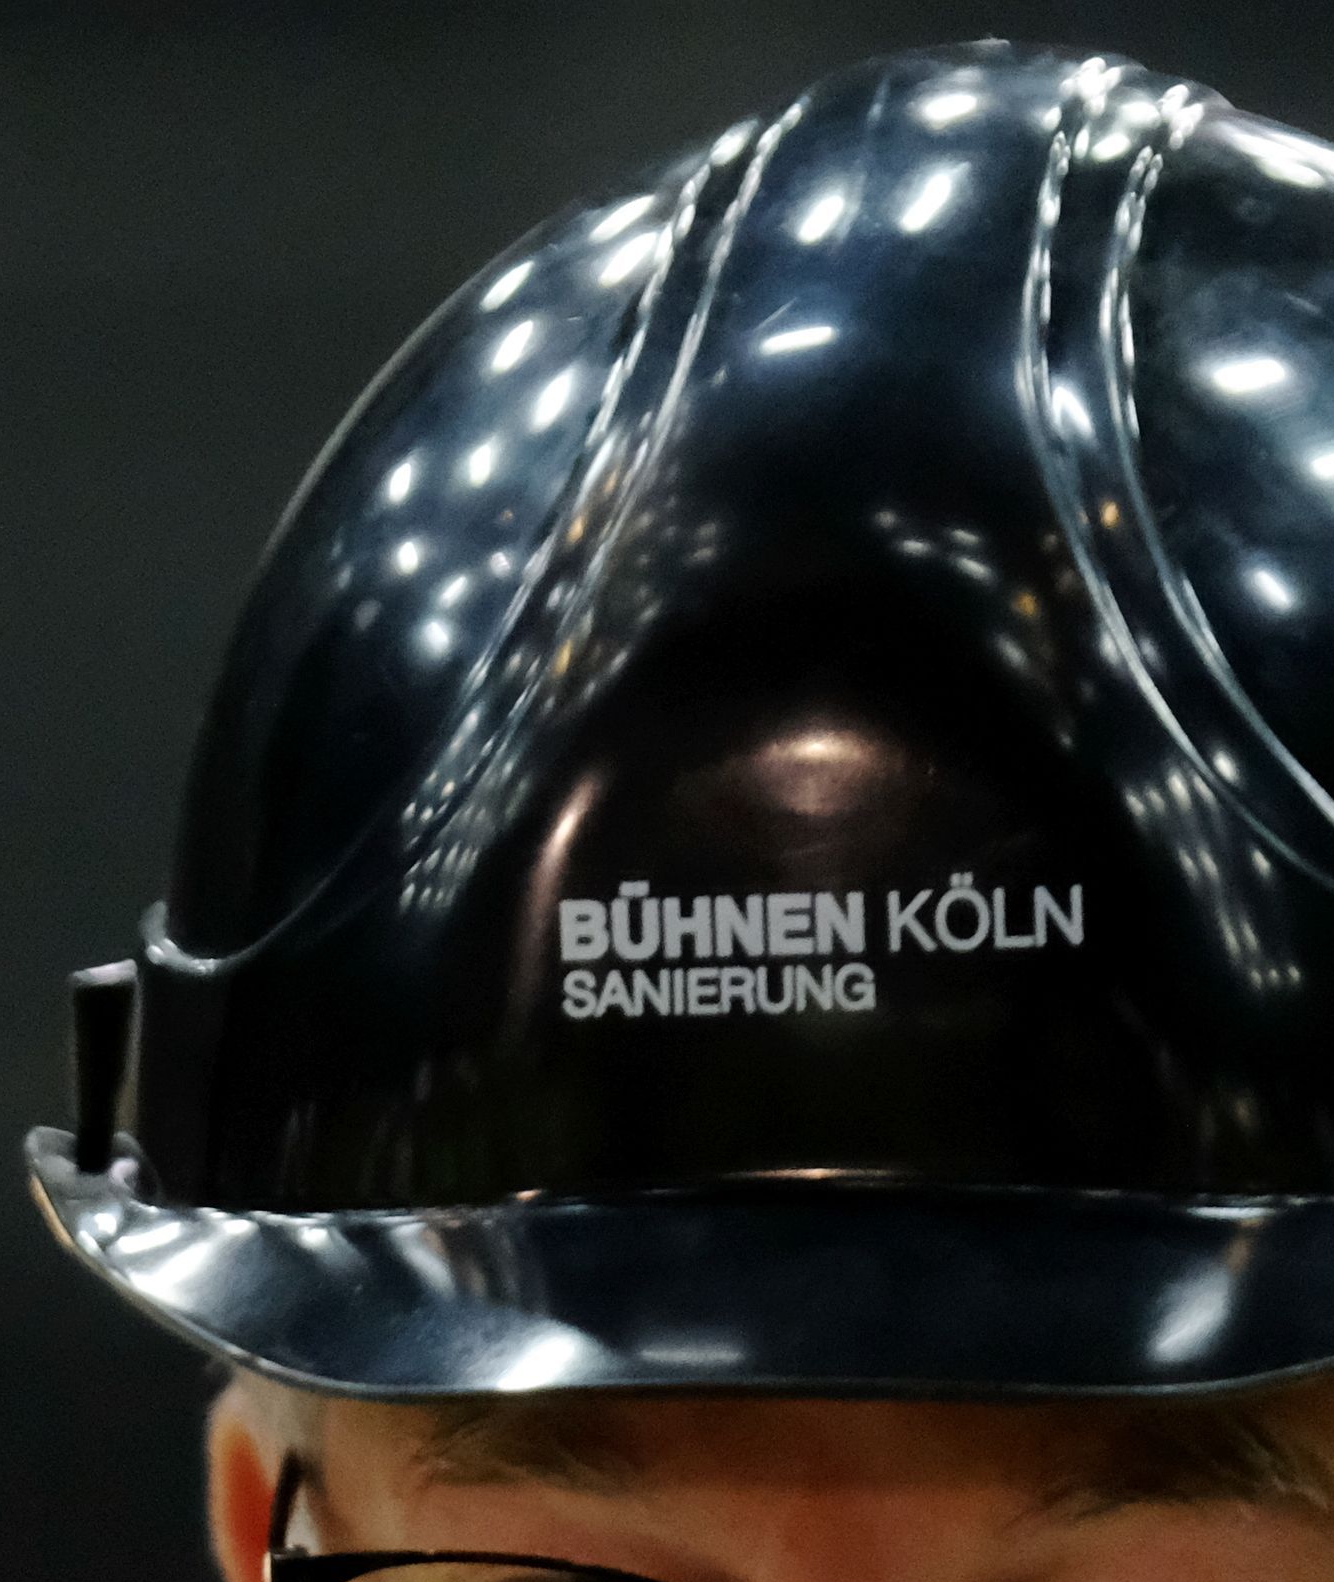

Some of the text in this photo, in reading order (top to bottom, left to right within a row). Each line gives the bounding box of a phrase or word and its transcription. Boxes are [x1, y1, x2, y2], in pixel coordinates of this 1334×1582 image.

[560, 872, 1085, 962] BÜHNEN KÖLN
[563, 962, 877, 1019] SANIERUNG
